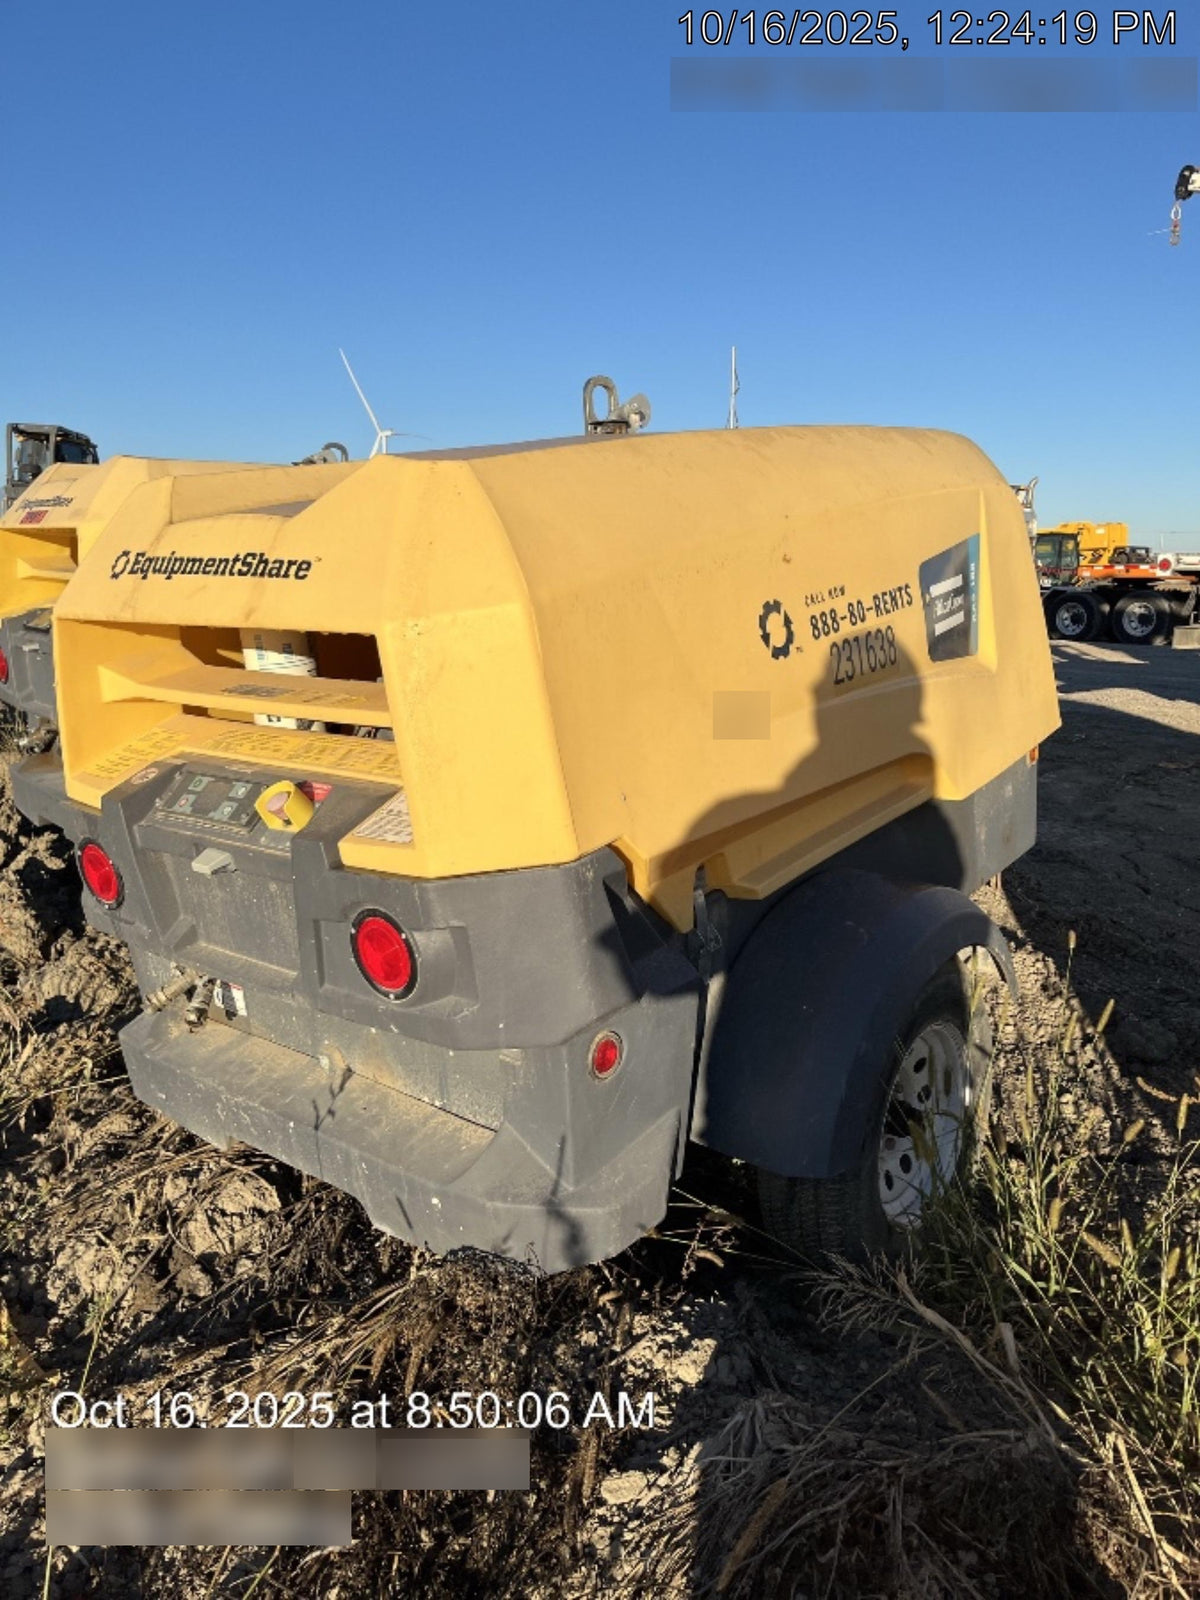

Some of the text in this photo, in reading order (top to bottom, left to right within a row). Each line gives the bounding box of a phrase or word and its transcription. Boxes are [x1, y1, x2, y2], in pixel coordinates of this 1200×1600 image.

[127, 551, 312, 580] EquipmentShare
[804, 591, 826, 607] CALL
[809, 583, 914, 641] 888-80-RENTS
[829, 625, 897, 686] 231638
